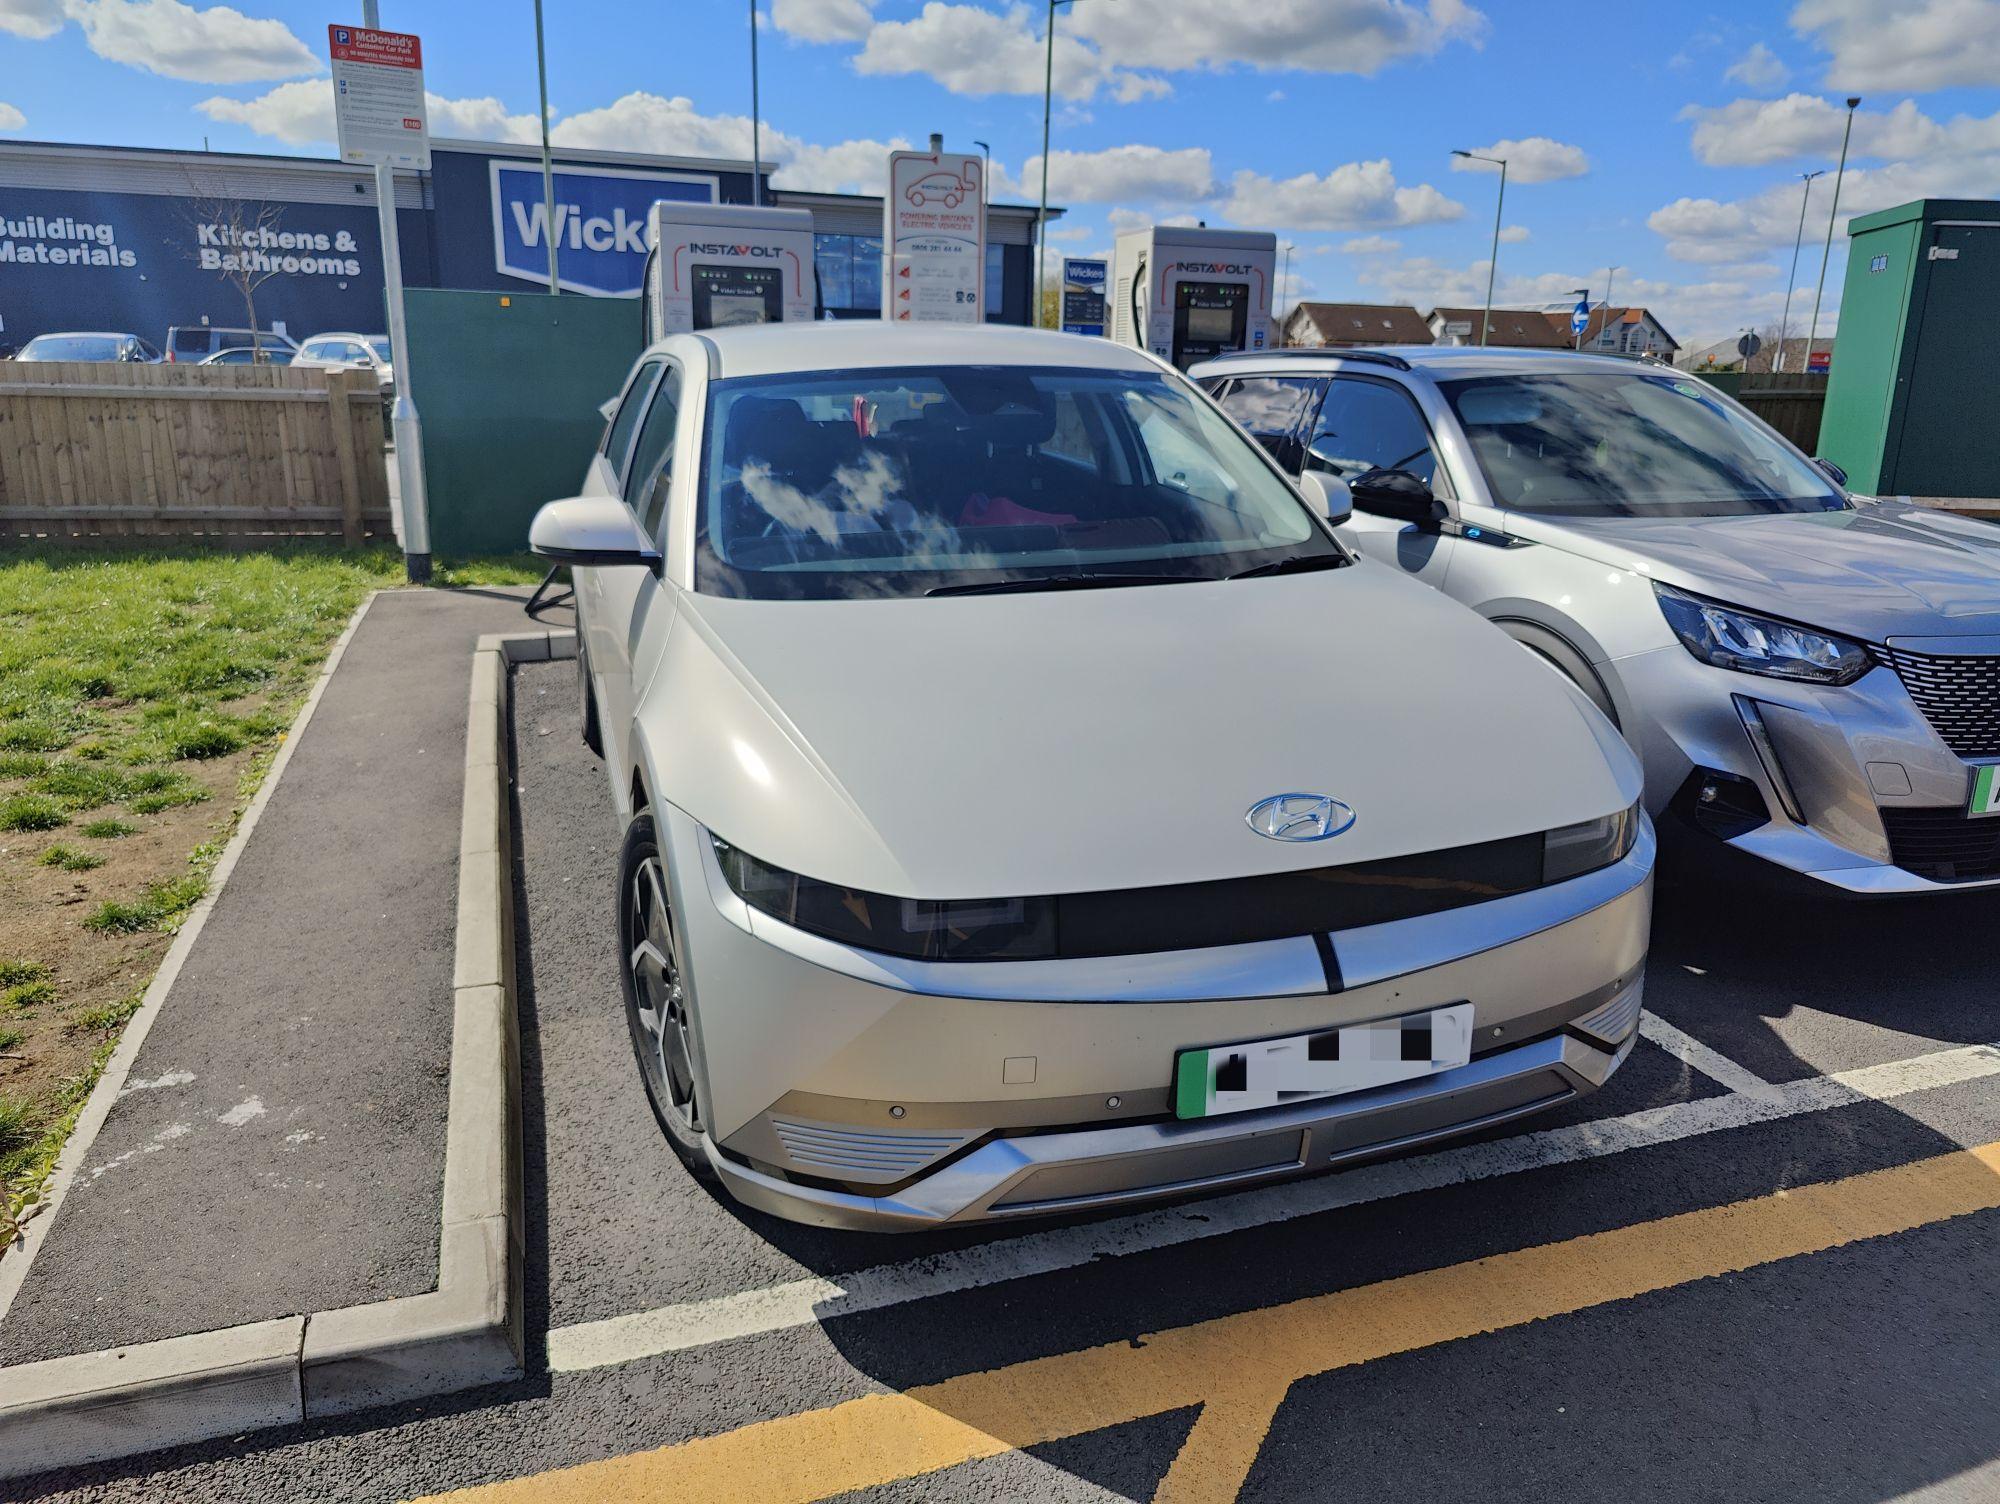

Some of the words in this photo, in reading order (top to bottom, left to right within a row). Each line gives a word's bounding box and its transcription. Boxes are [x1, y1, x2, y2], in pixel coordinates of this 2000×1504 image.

[355, 31, 413, 48] McDonald's
[355, 41, 385, 51] Customer
[386, 45, 397, 53] Car
[397, 47, 412, 55] Park
[510, 200, 651, 254] Wick
[198, 223, 331, 251] Kitchens
[335, 230, 358, 252] &
[0, 240, 137, 267] Materials
[690, 243, 784, 258] INSTAVOLT
[200, 248, 361, 276] Bathrooms
[1176, 262, 1252, 275] INSTAVOLT
[1069, 267, 1104, 279] Wickes
[720, 287, 736, 295] Video
